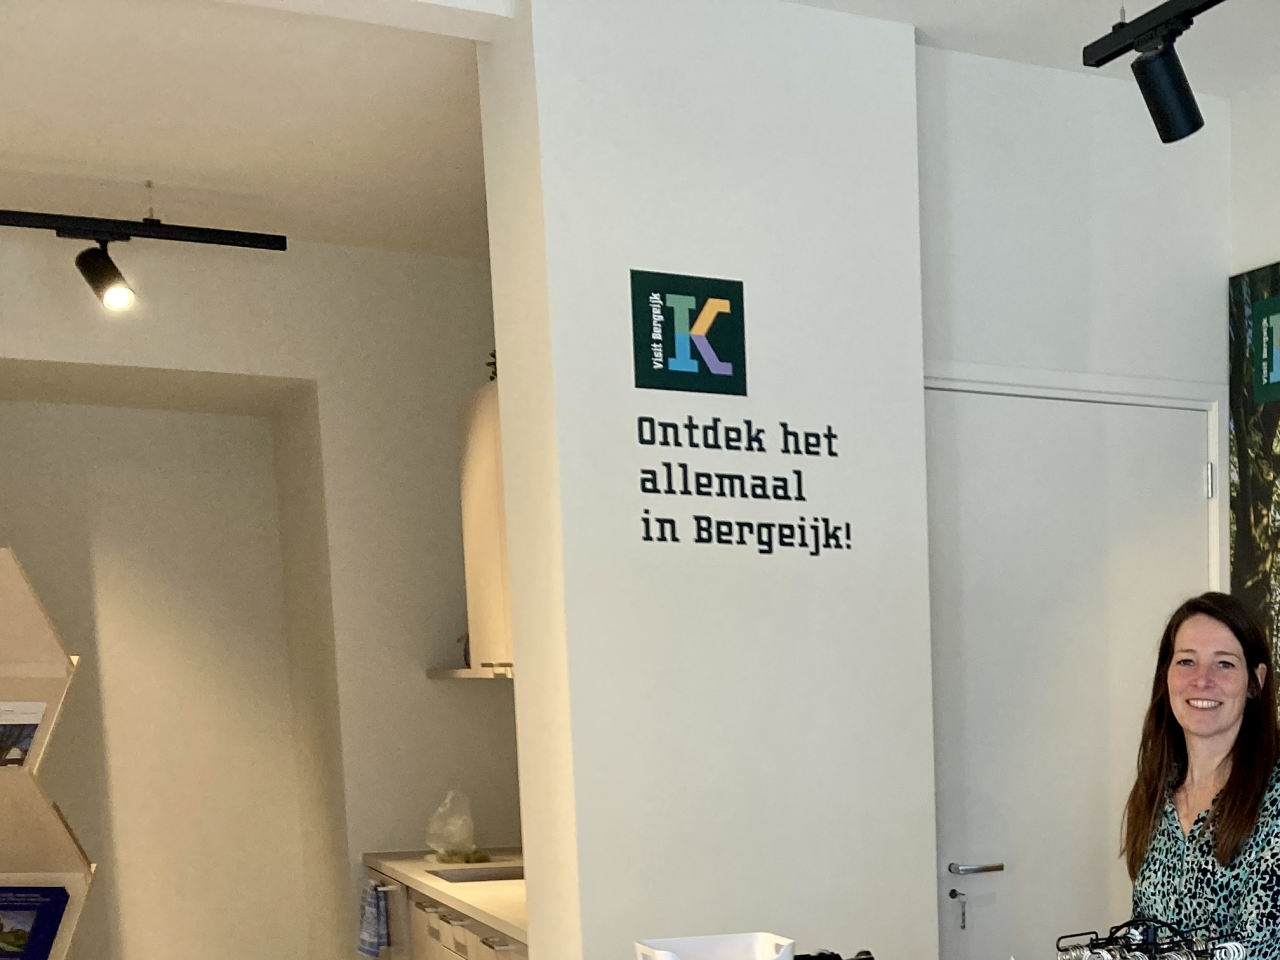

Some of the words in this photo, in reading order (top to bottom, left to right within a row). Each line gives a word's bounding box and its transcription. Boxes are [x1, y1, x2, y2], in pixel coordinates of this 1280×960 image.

[649, 292, 664, 342] Bergeijk
[653, 343, 664, 370] Visit
[637, 415, 767, 453] Ontdek
[779, 421, 839, 457] het
[639, 461, 808, 502] allemaal
[641, 508, 681, 543] in
[693, 514, 852, 556] Bergeijk!
